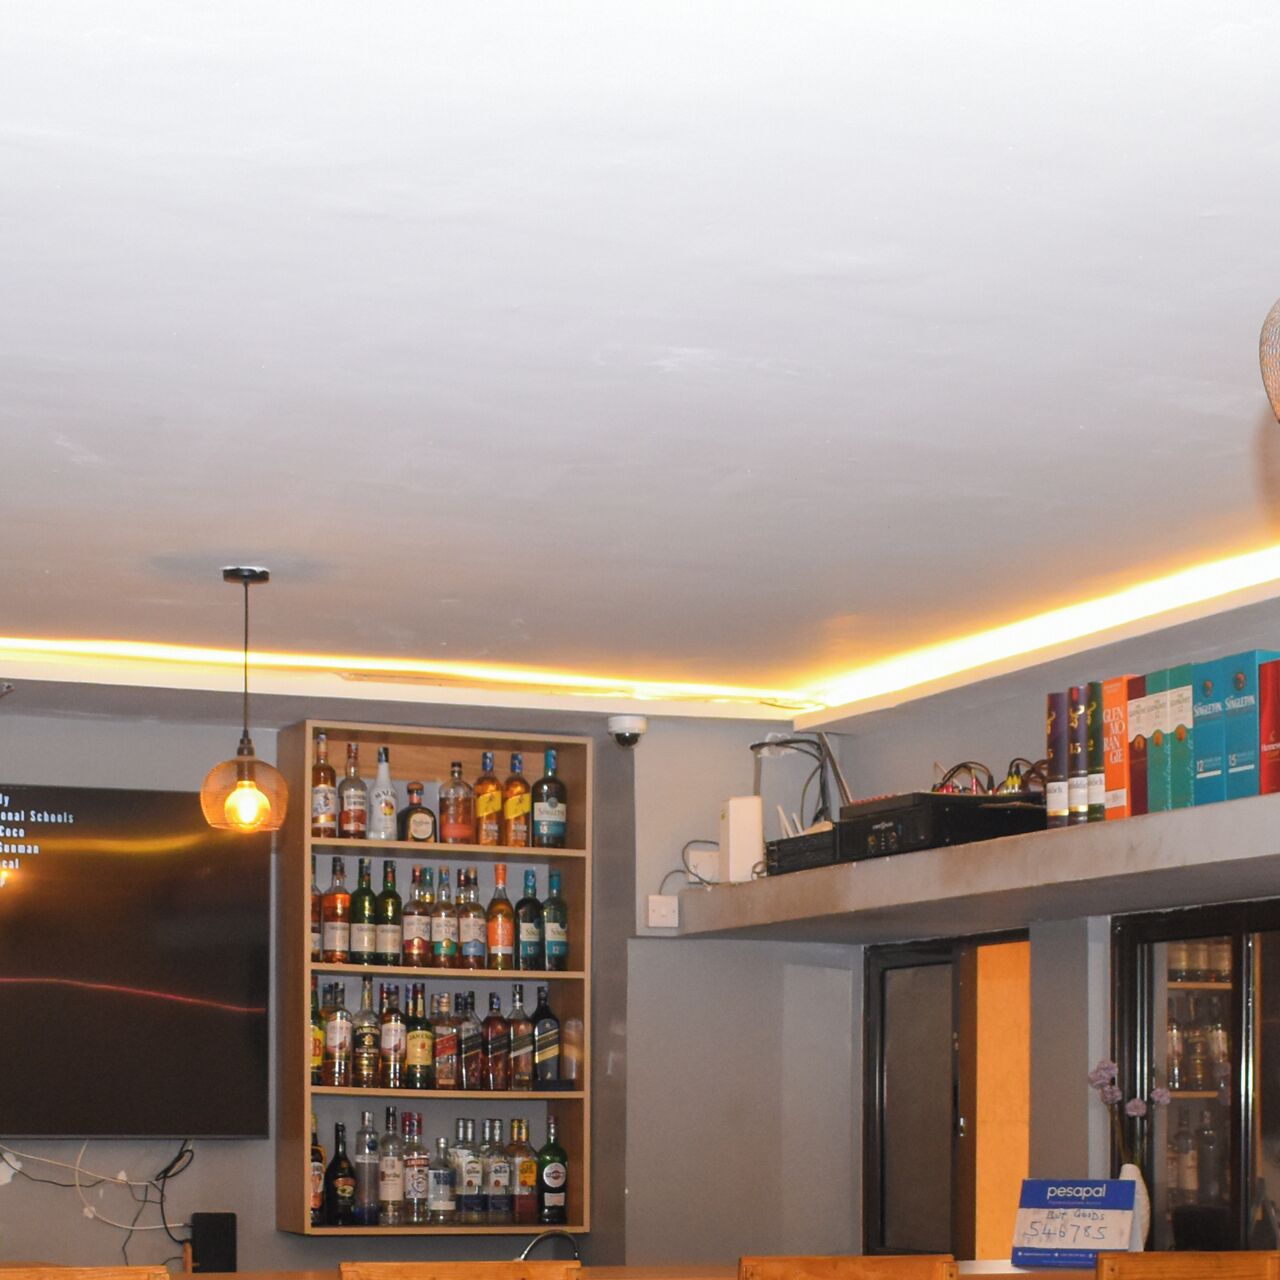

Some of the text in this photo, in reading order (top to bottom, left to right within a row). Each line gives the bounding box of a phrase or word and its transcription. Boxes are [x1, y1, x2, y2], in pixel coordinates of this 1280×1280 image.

[30, 810, 74, 823] Schools
[0, 825, 25, 838] Coco
[1046, 1183, 1107, 1200] pesapal
[1024, 1220, 1108, 1244] 546785
